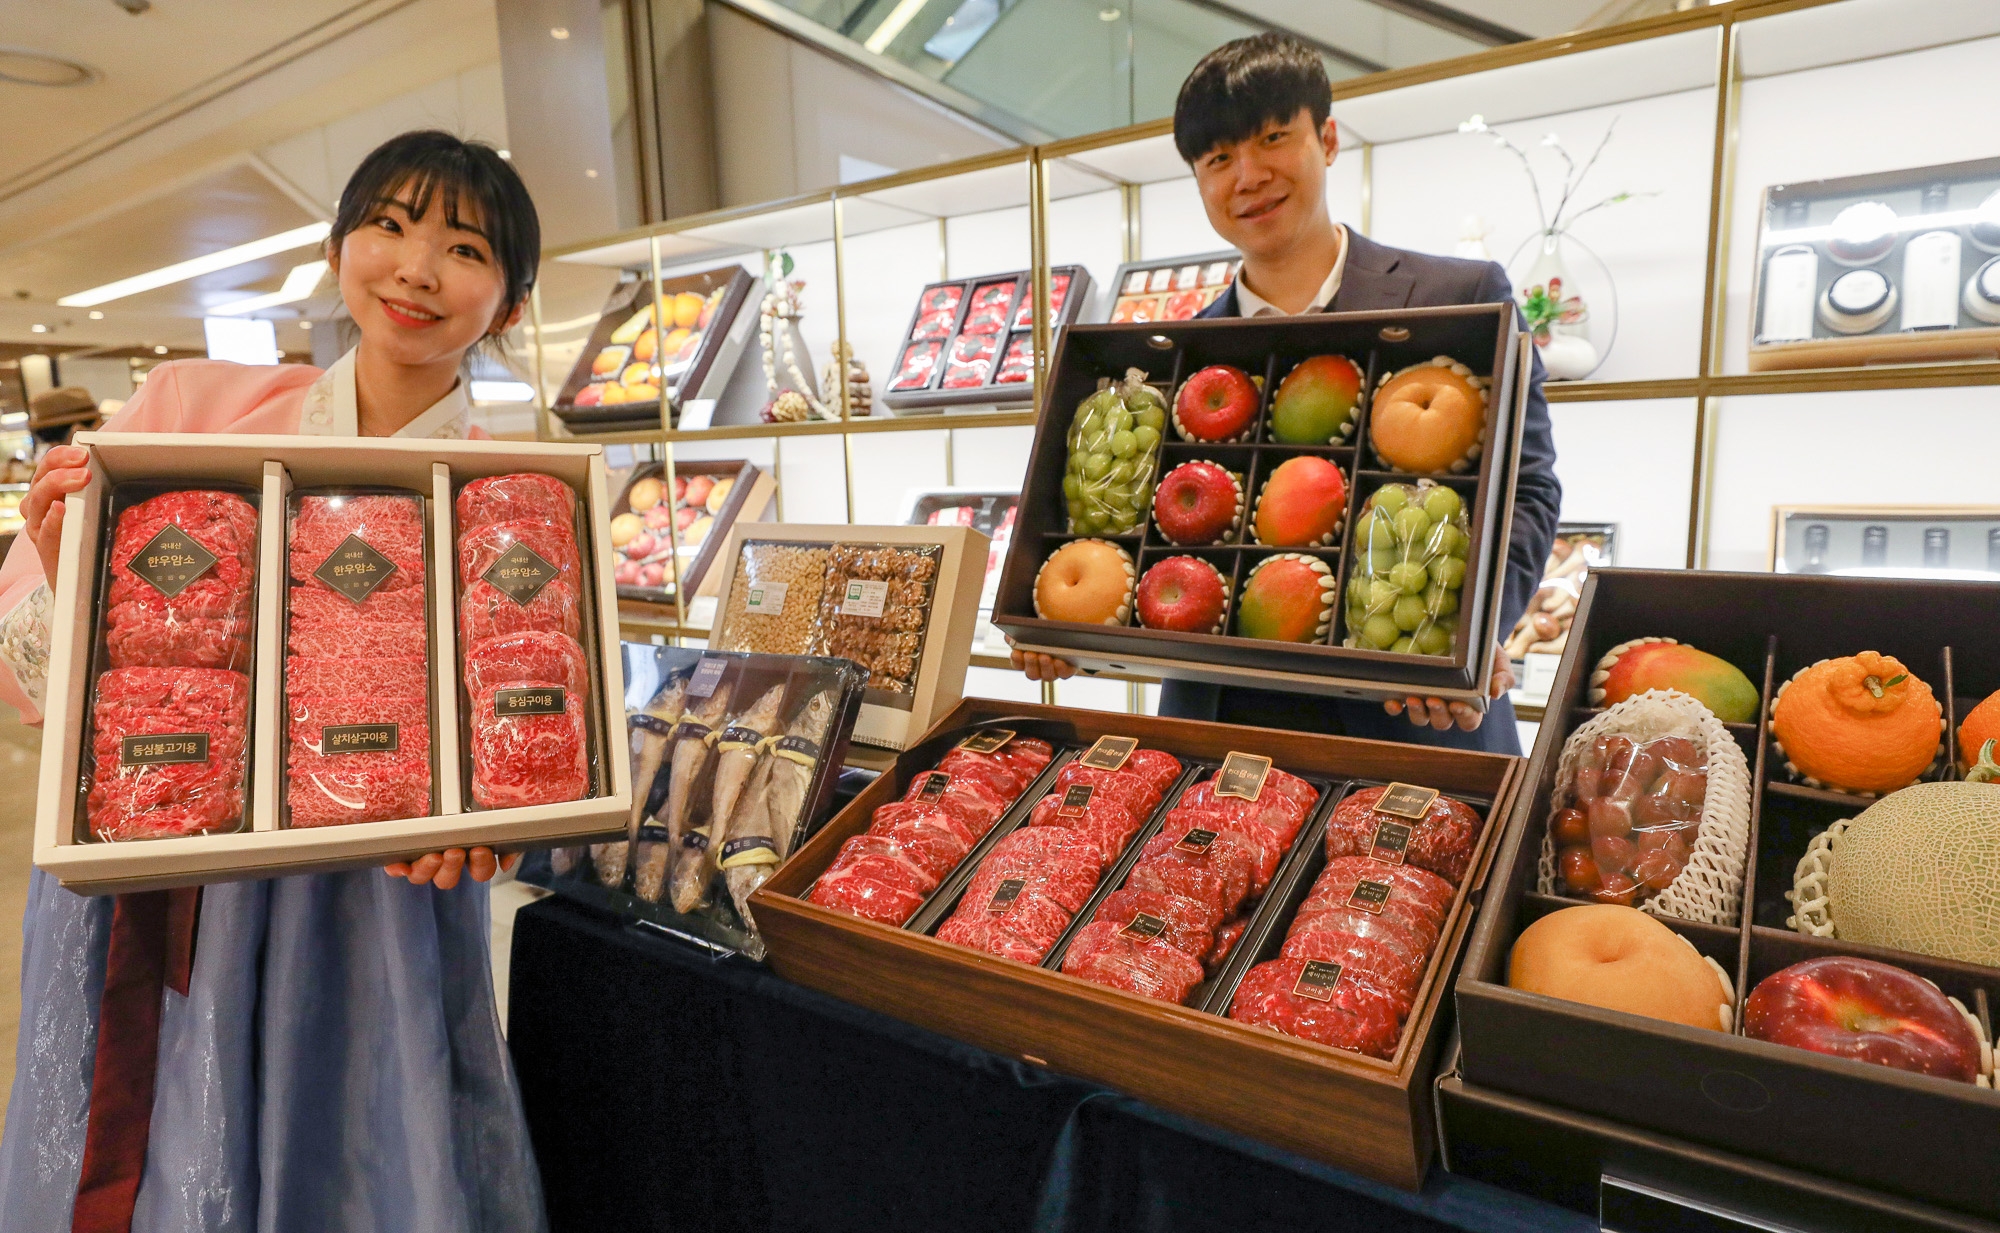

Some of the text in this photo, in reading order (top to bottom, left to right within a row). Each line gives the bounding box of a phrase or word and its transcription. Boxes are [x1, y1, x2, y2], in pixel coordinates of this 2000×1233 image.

[160, 542, 182, 550] 국내산
[147, 554, 196, 568] 한우암소
[344, 551, 363, 559] 국내산
[333, 562, 377, 577] 한우암소
[499, 567, 541, 579] 한우암소
[508, 695, 553, 707] 등심구이용
[331, 731, 389, 746] 살치살구이용
[132, 742, 197, 757] 등심불고기용
